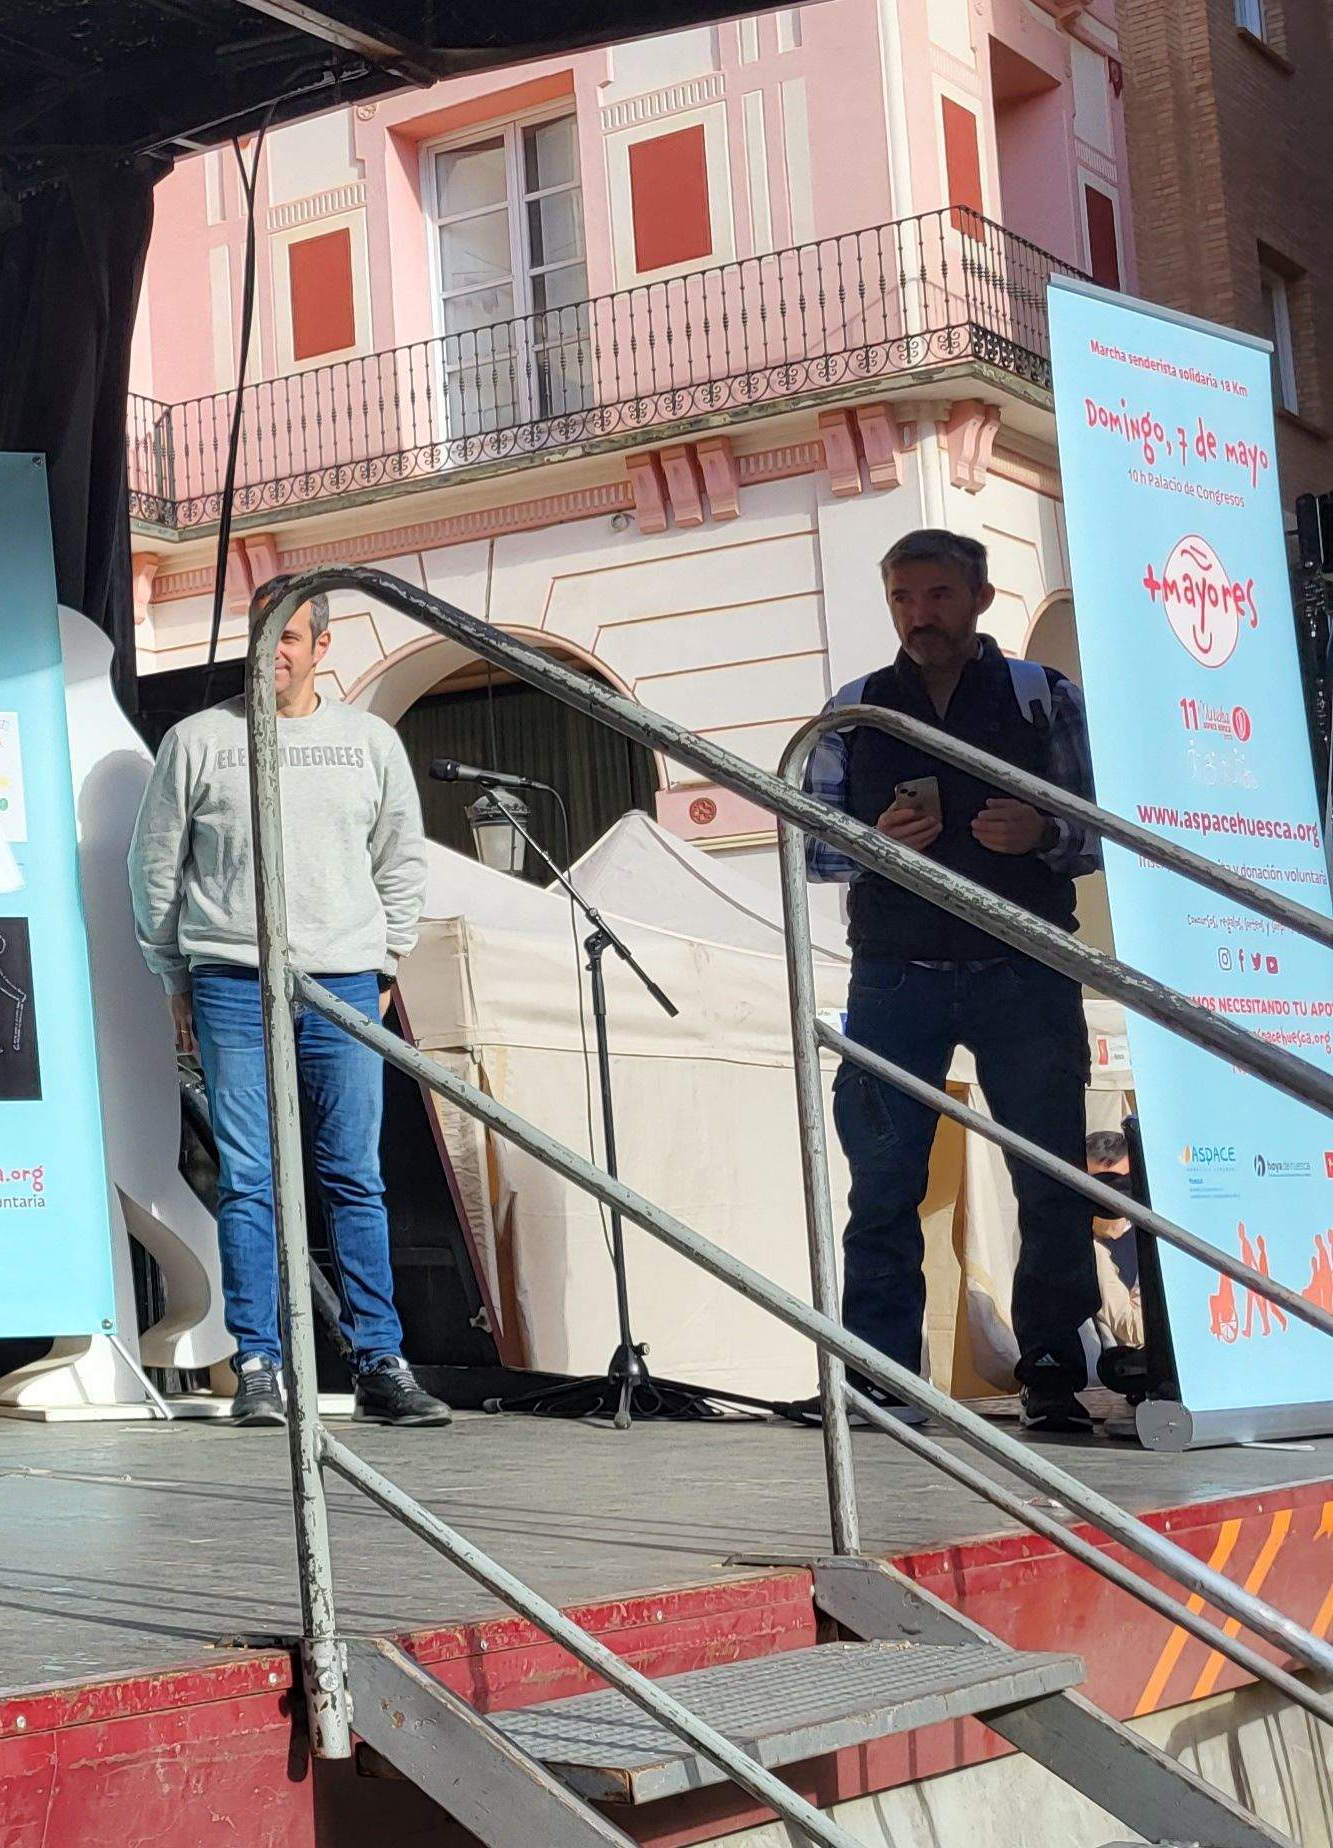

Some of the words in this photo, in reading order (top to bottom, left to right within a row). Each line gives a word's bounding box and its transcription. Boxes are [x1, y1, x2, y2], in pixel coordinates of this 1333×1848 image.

[1089, 338, 1128, 363] Marcha
[1127, 351, 1177, 379] senderista
[1178, 367, 1219, 391] solidaria
[1219, 378, 1231, 393] 18
[1231, 380, 1249, 398] Km
[1084, 397, 1173, 466] Domingo,
[1176, 427, 1188, 467] 7
[1195, 417, 1218, 463] de
[1224, 440, 1269, 490] mayo
[1127, 468, 1139, 483] 10
[1139, 469, 1147, 485] h
[1147, 473, 1183, 494] Palacio
[1183, 479, 1195, 497] de
[1195, 484, 1245, 509] Congresos
[1142, 563, 1259, 634] +mayores
[1179, 697, 1199, 732] 11
[288, 746, 364, 769] DEGREES
[1136, 804, 1321, 849] www.aspacehuesca.org
[1284, 868, 1328, 886] voluntaria
[1218, 997, 1291, 1016] NECESITANDO
[1292, 1000, 1308, 1017] TU
[1310, 1001, 1333, 1017] APO
[1191, 1145, 1237, 1165] ASPACE
